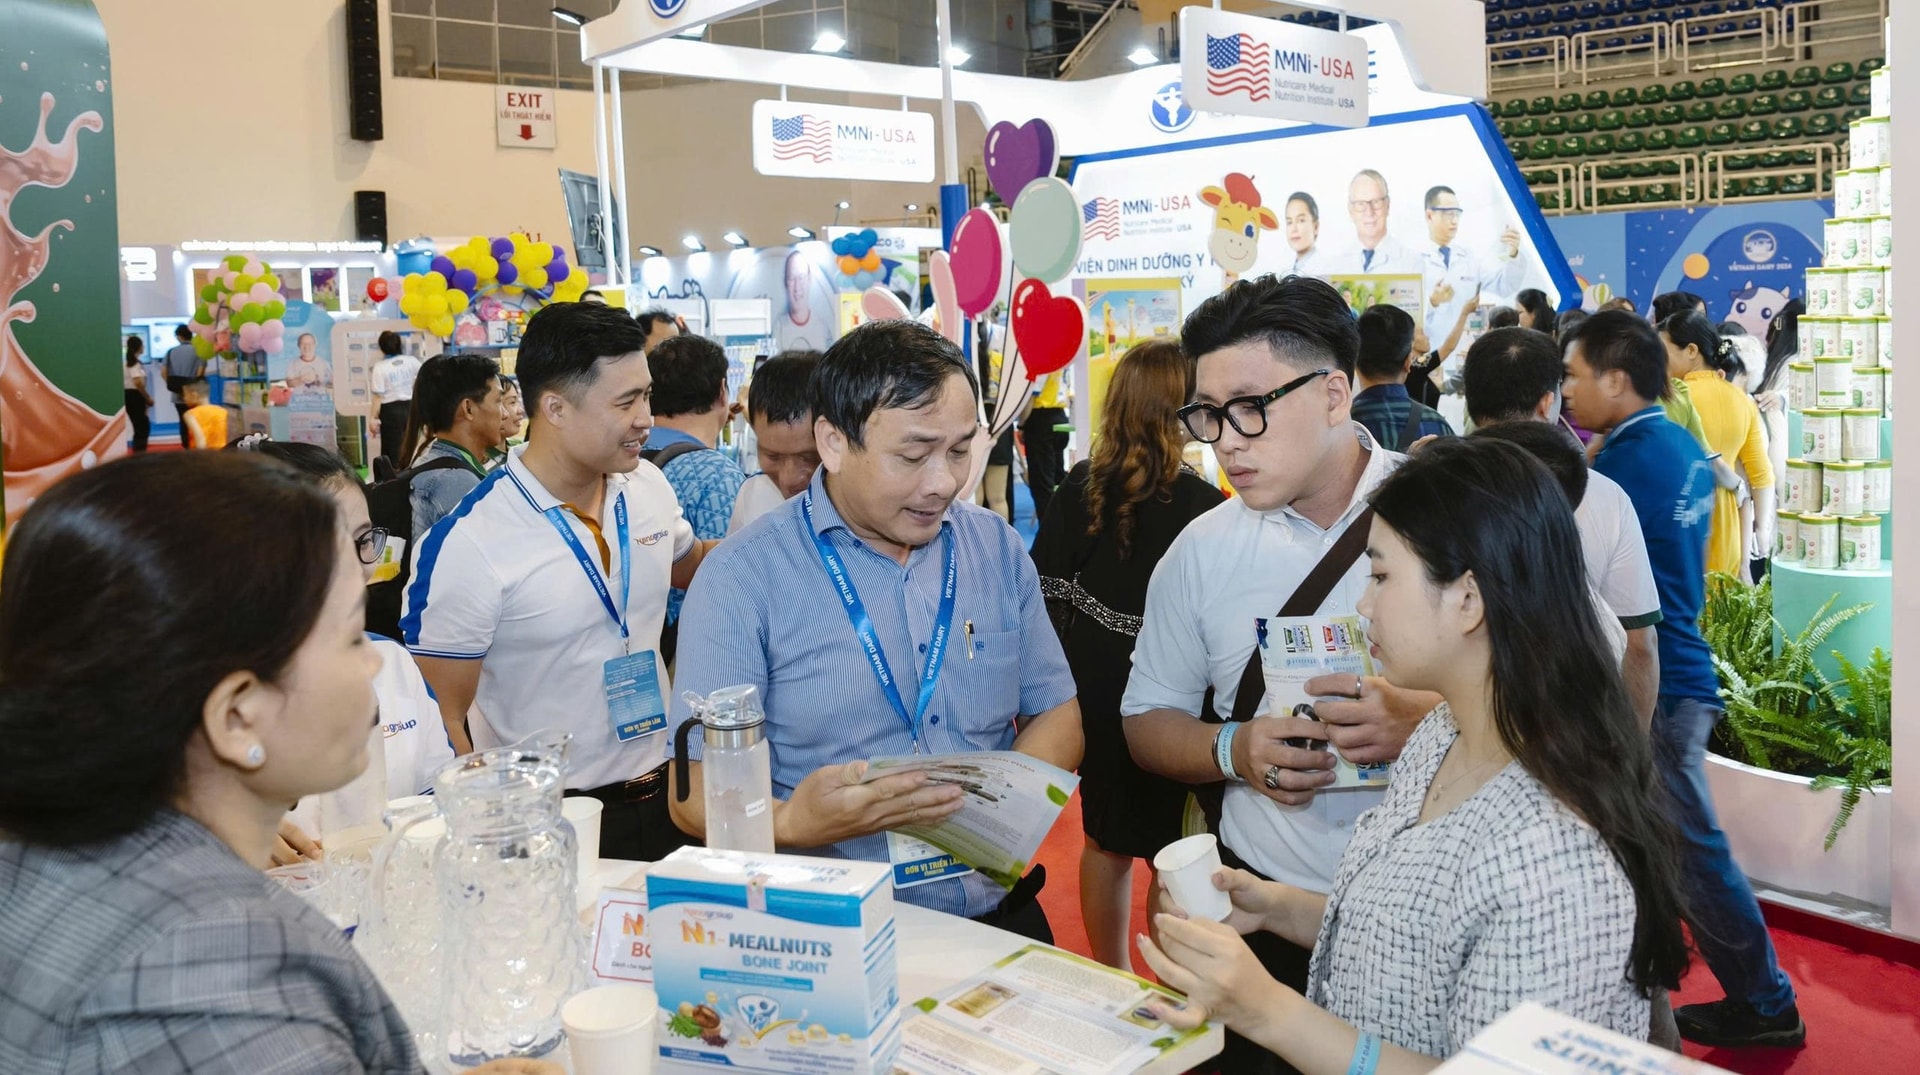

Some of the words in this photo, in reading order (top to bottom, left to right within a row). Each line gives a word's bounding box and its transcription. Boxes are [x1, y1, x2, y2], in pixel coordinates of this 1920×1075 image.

[507, 92, 543, 108] EXIT
[1107, 258, 1137, 273] DINH
[825, 554, 841, 575] DAIRY
[835, 573, 855, 606] VIETNAM
[862, 631, 877, 654] DAIRY
[871, 653, 890, 687] VIETNAM
[926, 646, 940, 680] VIETNAM
[934, 624, 946, 647] DAIRY
[728, 932, 833, 958] MEALNUTS
[741, 954, 783, 971] BONE
[786, 959, 828, 975] JOINT
